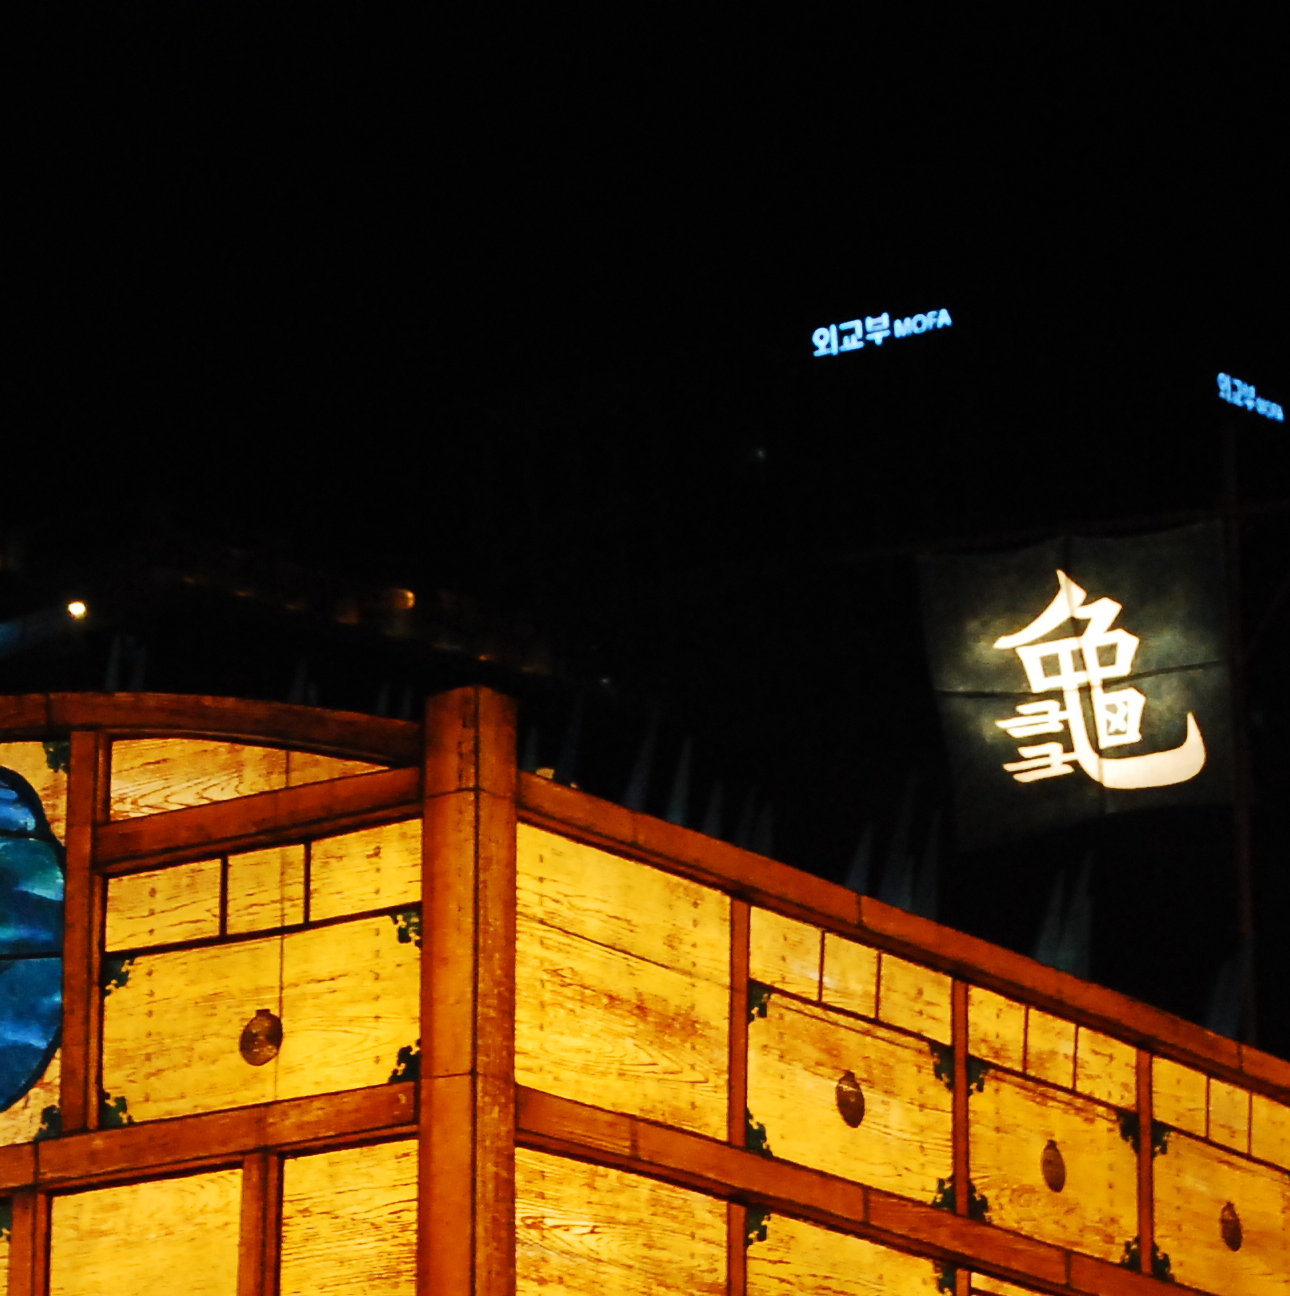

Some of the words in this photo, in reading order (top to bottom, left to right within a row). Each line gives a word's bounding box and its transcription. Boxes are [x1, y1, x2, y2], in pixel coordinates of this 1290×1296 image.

[811, 312, 891, 357] 외교부
[893, 308, 953, 339] MOFA
[993, 569, 1206, 789] 龜
